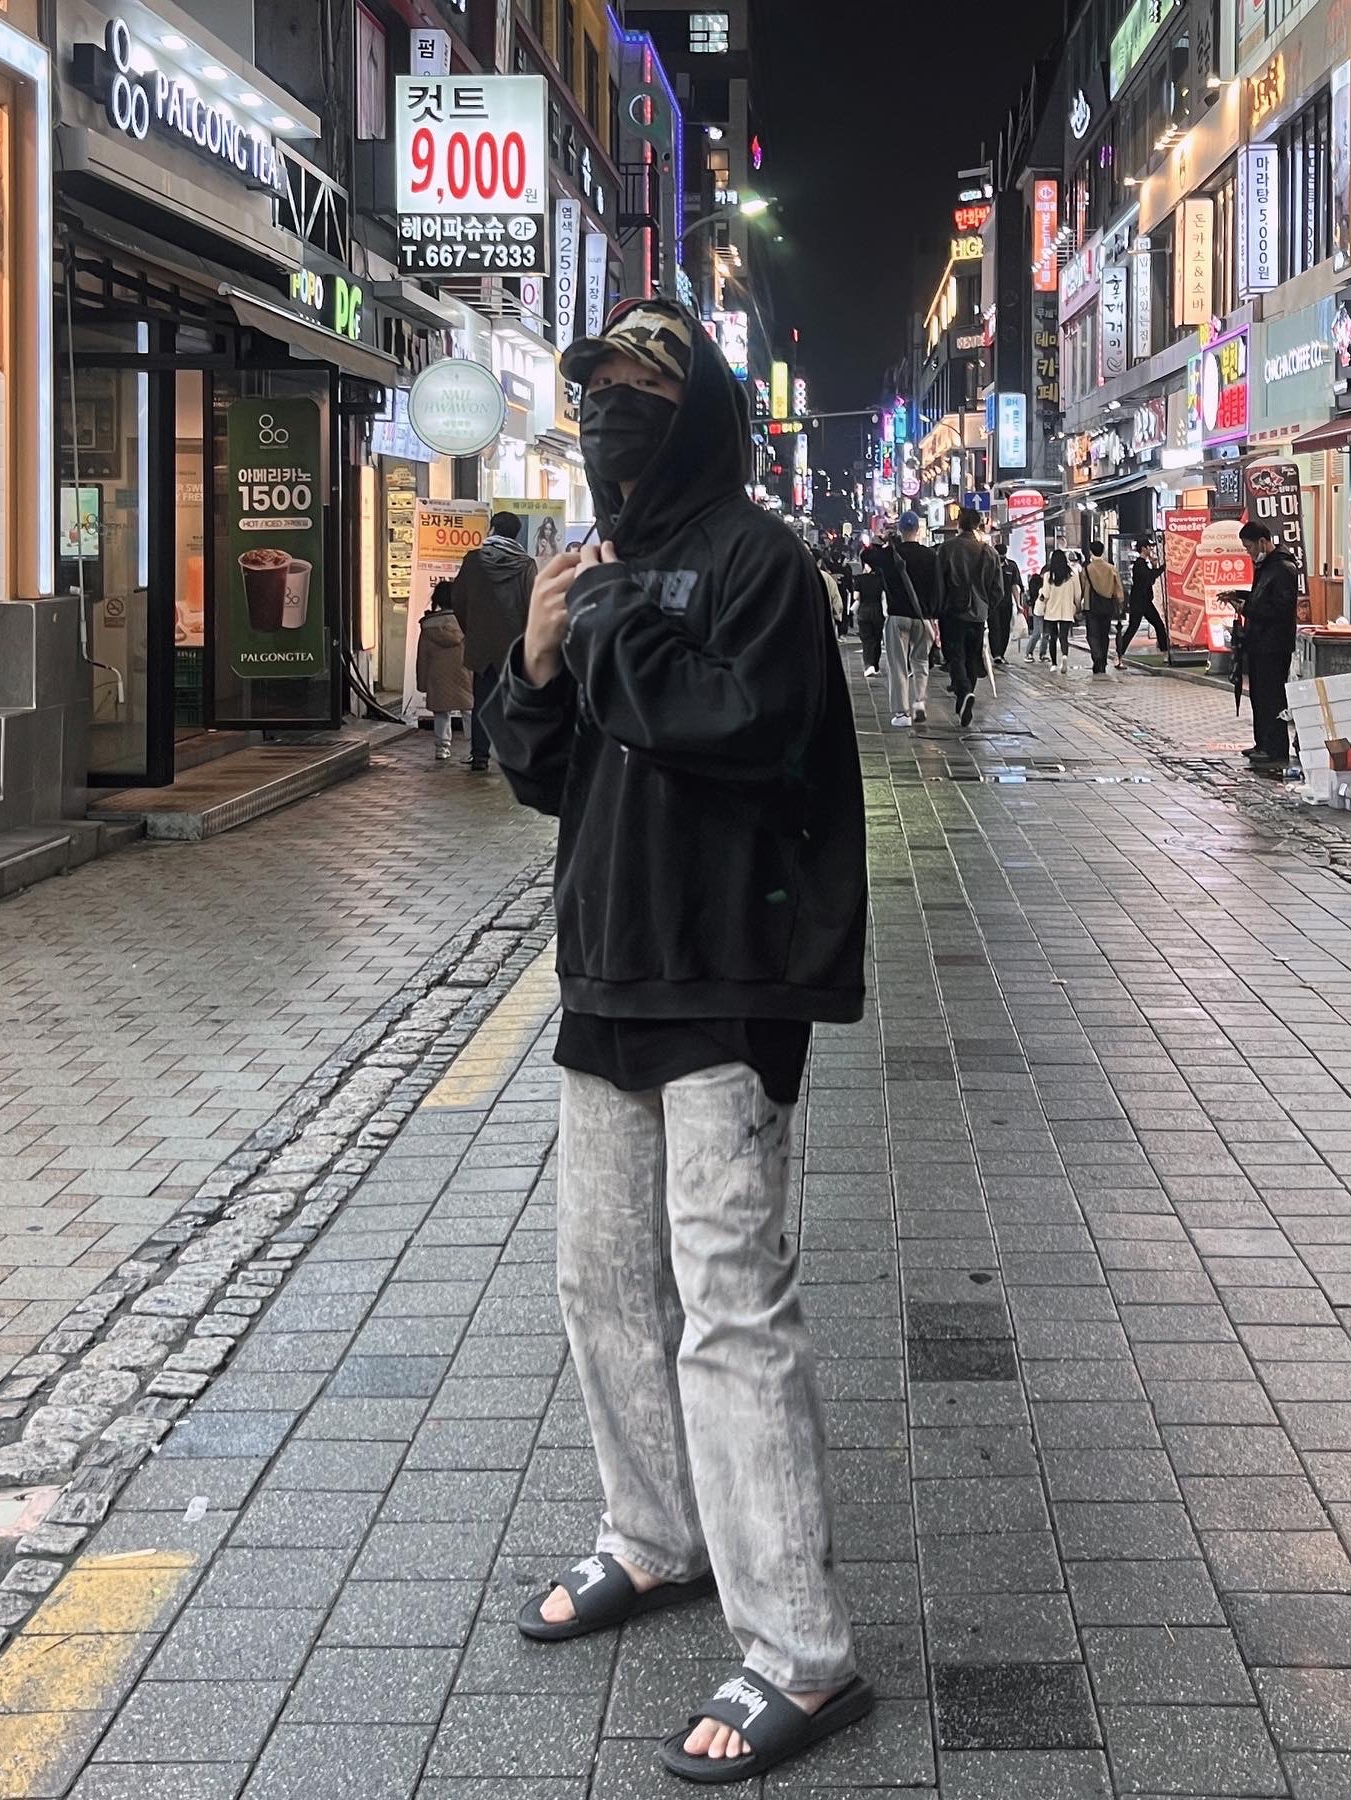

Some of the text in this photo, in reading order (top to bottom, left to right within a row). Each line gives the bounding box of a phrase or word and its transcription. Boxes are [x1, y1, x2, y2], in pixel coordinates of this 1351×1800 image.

[408, 84, 489, 123] 컷트
[1256, 156, 1270, 203] 마라탕
[401, 216, 532, 241] 헤어파슈슈 2F
[561, 206, 573, 233] 염색
[401, 244, 536, 267] T.667-7333
[238, 468, 311, 483] 아메리카노
[238, 484, 312, 511] 1500
[421, 514, 464, 528] 남자 커트
[240, 653, 314, 662] PALGONGTEA
